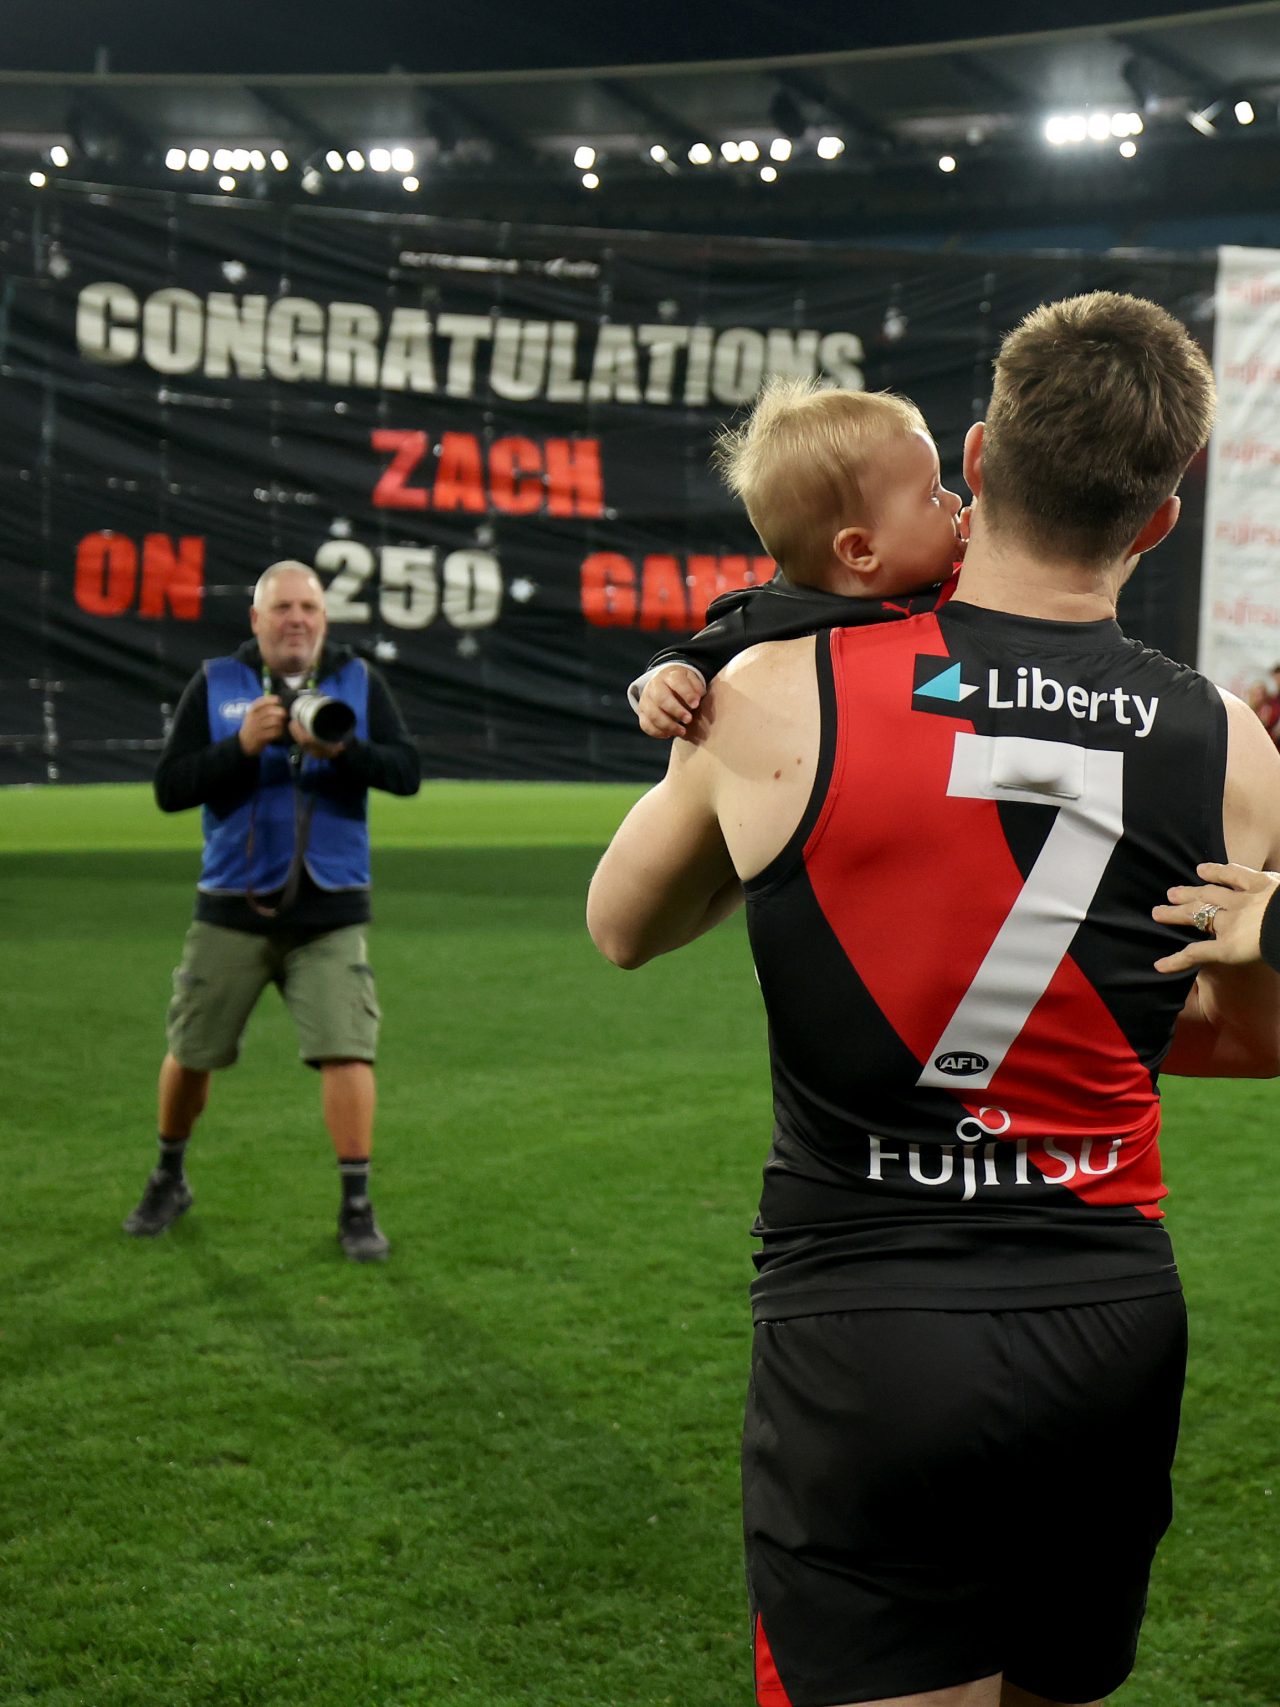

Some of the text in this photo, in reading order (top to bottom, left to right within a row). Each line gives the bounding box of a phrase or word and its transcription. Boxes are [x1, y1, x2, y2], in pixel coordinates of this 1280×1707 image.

[76, 282, 866, 406] CONGRATULATIONS
[371, 429, 604, 519] ZACH
[74, 530, 205, 620] ON
[315, 540, 502, 630] 250
[988, 667, 1159, 738] Liberty
[916, 731, 1124, 1089] 7
[939, 1056, 984, 1070] AFL
[866, 1134, 1123, 1202] FUJITSU
